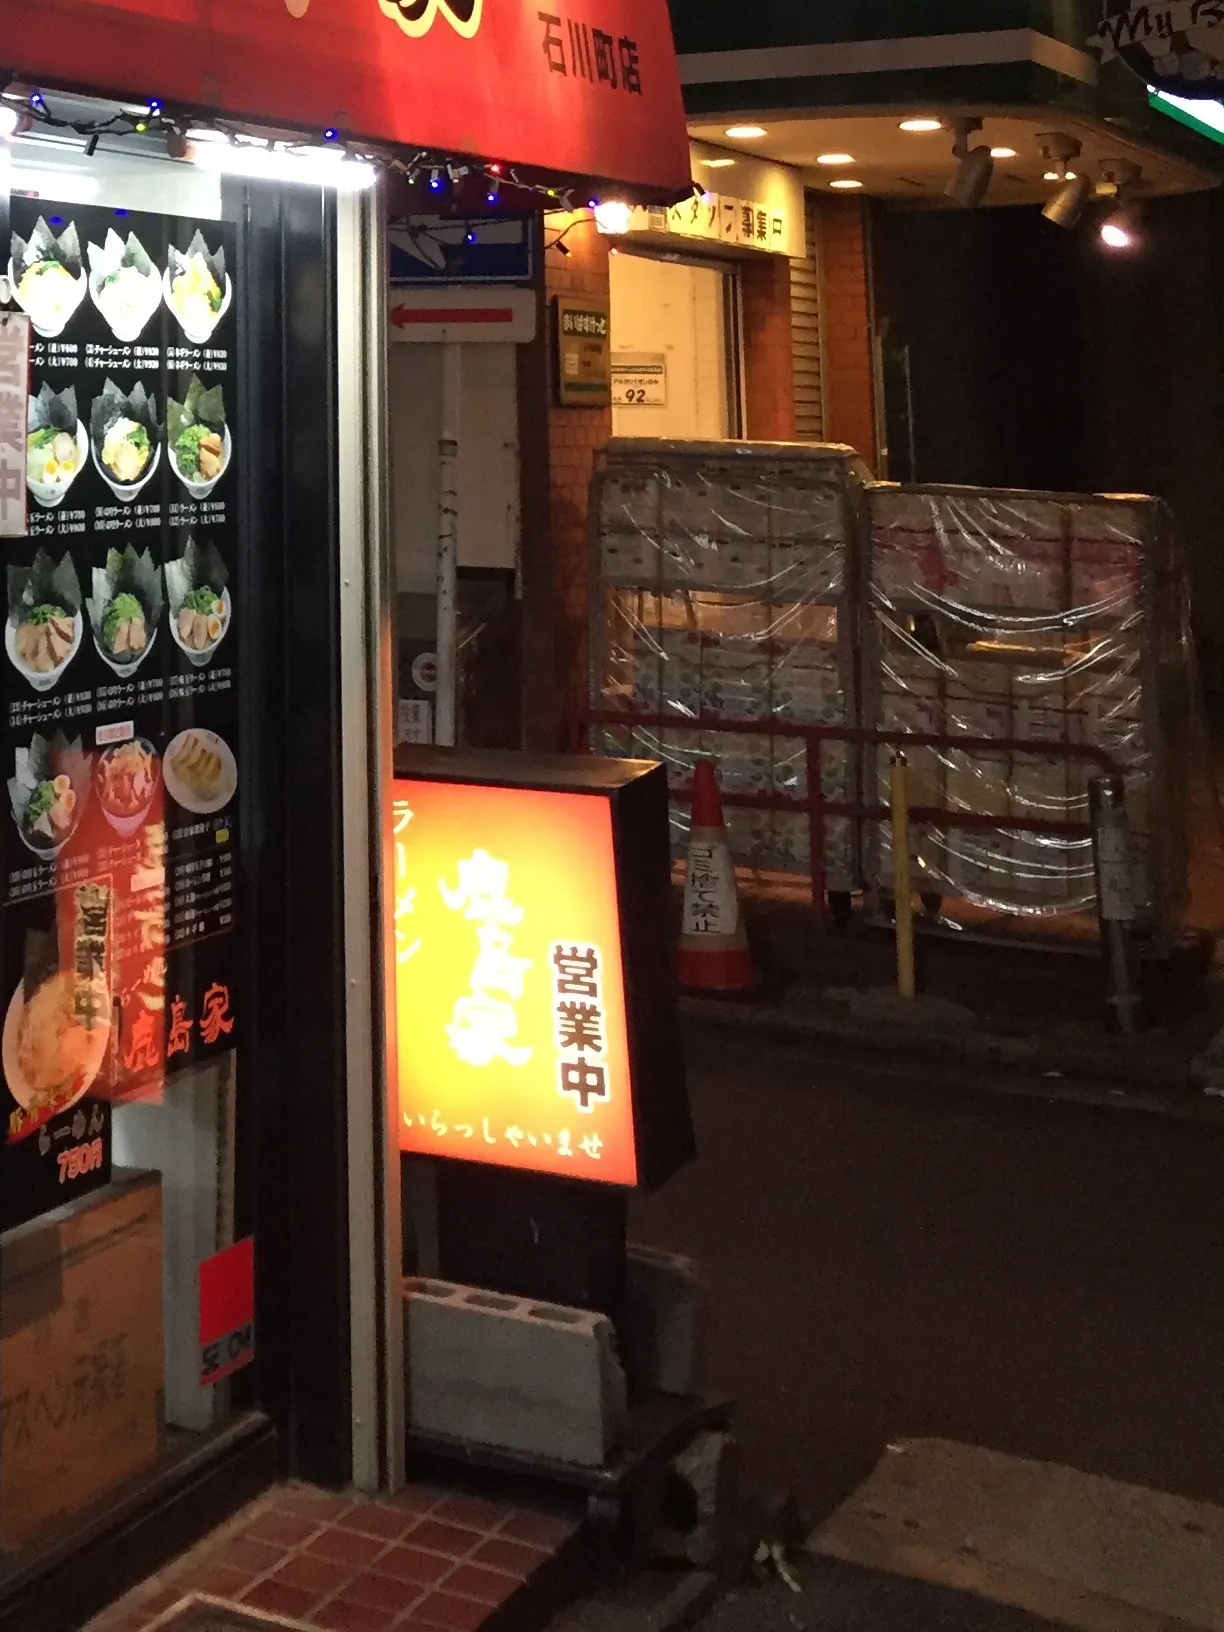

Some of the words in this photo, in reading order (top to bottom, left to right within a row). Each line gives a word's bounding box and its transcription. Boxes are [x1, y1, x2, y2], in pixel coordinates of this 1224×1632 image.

[537, 11, 643, 96] 石川町店
[551, 943, 608, 1109] 営業中
[403, 1109, 605, 1161] いらっしゃいませ
